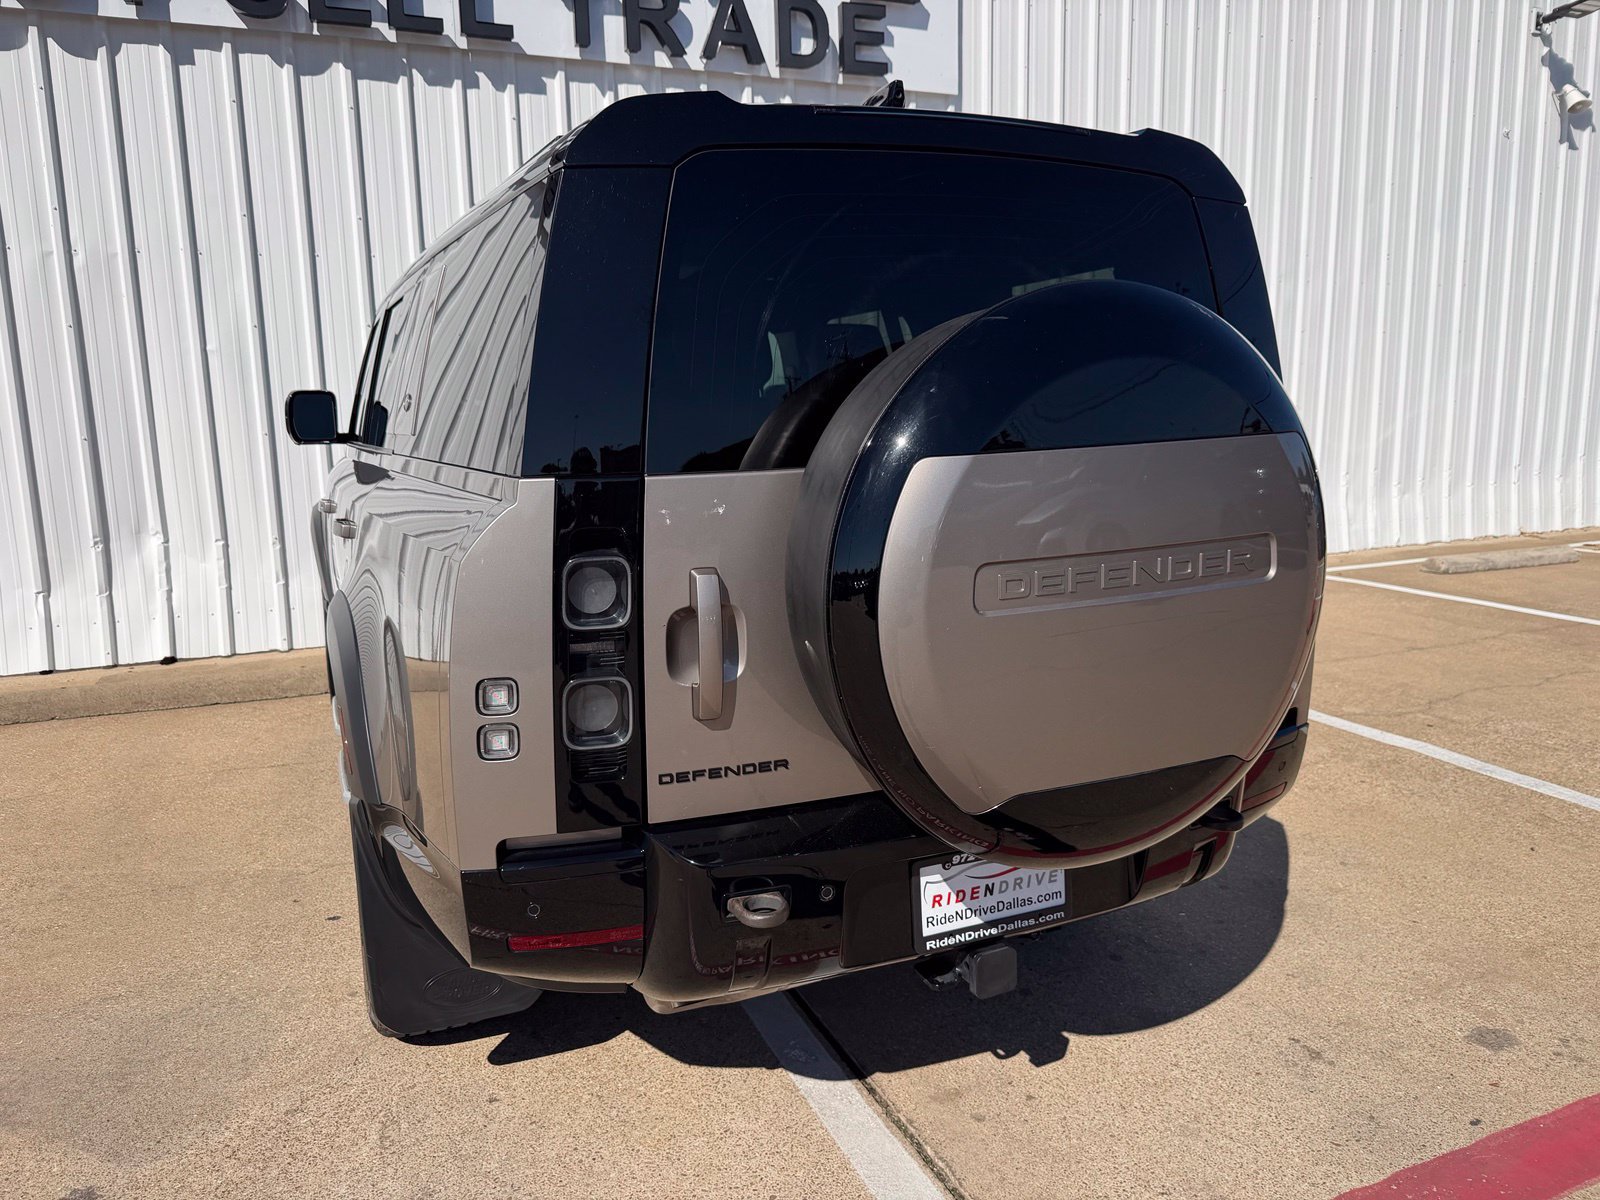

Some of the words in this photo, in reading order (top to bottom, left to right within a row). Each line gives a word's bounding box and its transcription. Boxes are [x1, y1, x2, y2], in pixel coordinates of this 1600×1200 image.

[998, 549, 1254, 601] DEFENDER
[658, 758, 790, 786] DEFENDER
[926, 890, 1063, 929] RideNDriveDallas.com
[926, 910, 1065, 951] RideNDriveDallas.com
